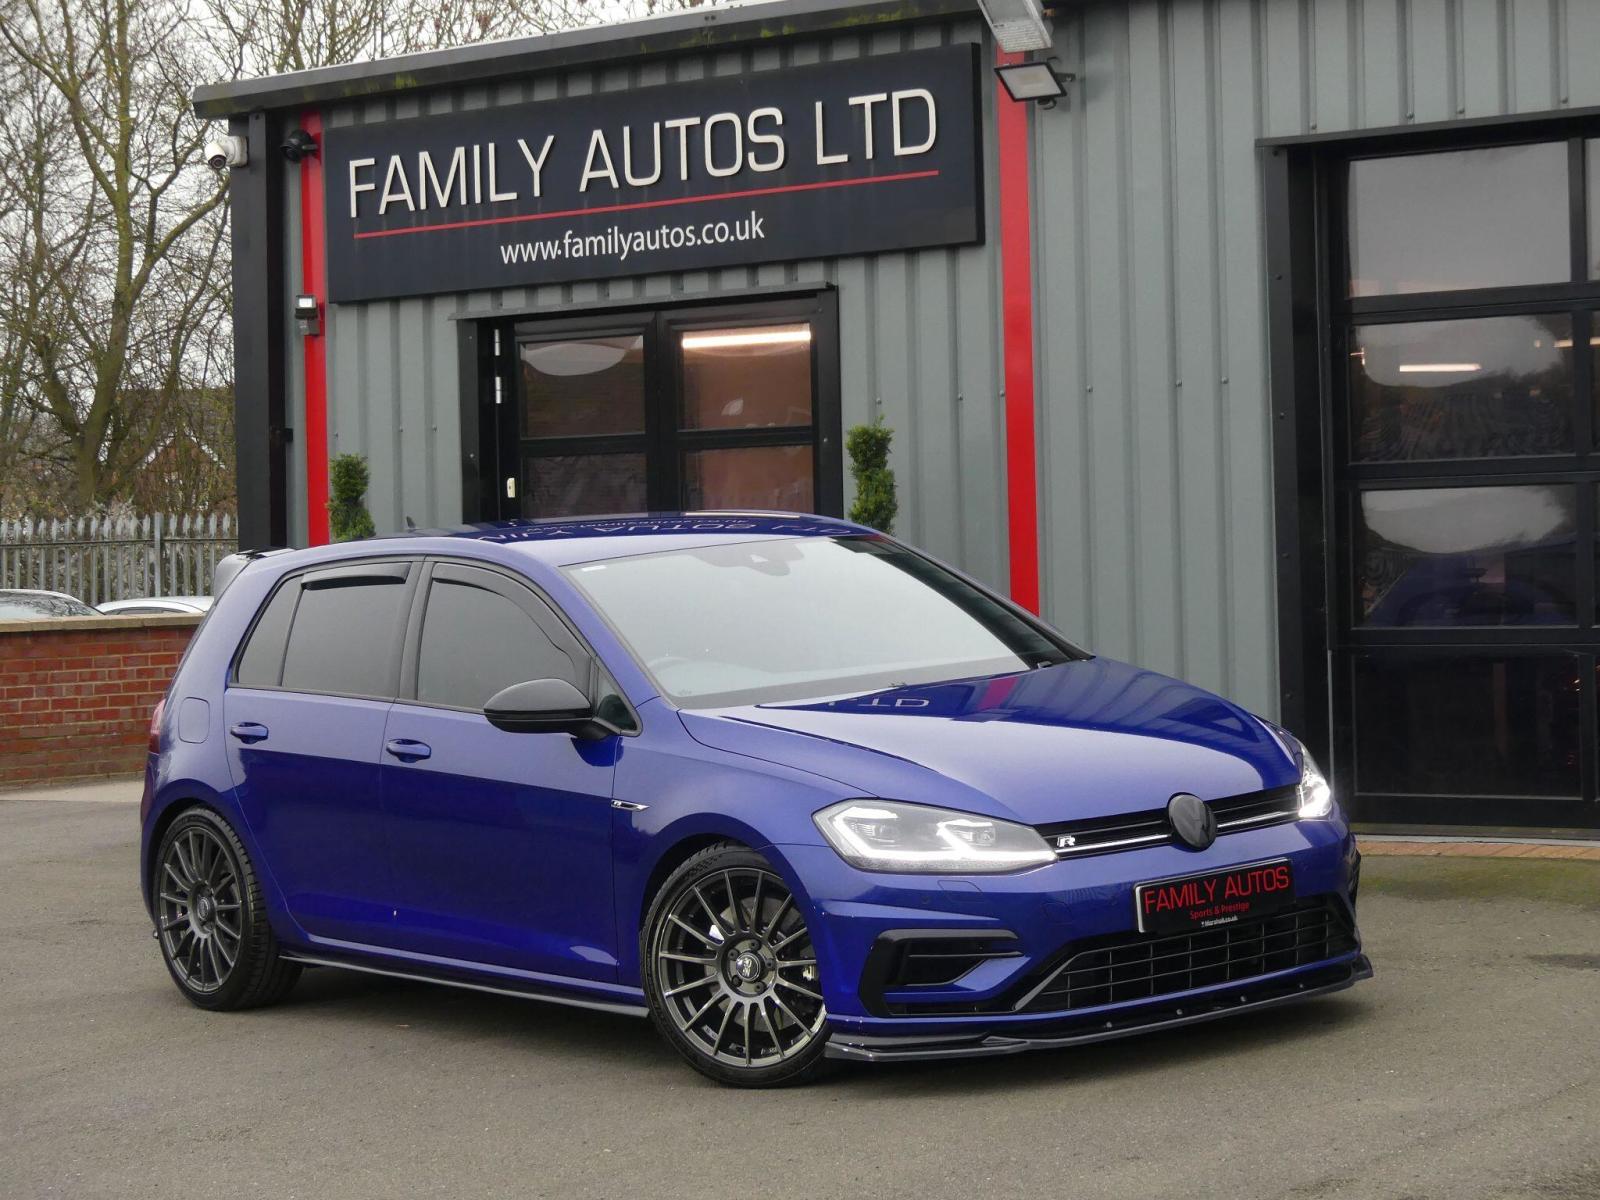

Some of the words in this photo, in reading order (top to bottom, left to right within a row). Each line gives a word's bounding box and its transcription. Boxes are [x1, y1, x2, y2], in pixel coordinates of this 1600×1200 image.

[349, 135, 554, 218] FAMILY
[579, 107, 785, 193] AUTOS
[816, 88, 937, 166] LTD
[500, 211, 765, 264] www.familyautos.co.uk
[1057, 836, 1076, 848] R
[1144, 878, 1217, 914] FAMILY
[1224, 866, 1289, 899] AUTOS
[1189, 908, 1214, 921] Sports
[1214, 904, 1221, 916] &
[1220, 900, 1250, 915] Prestige
